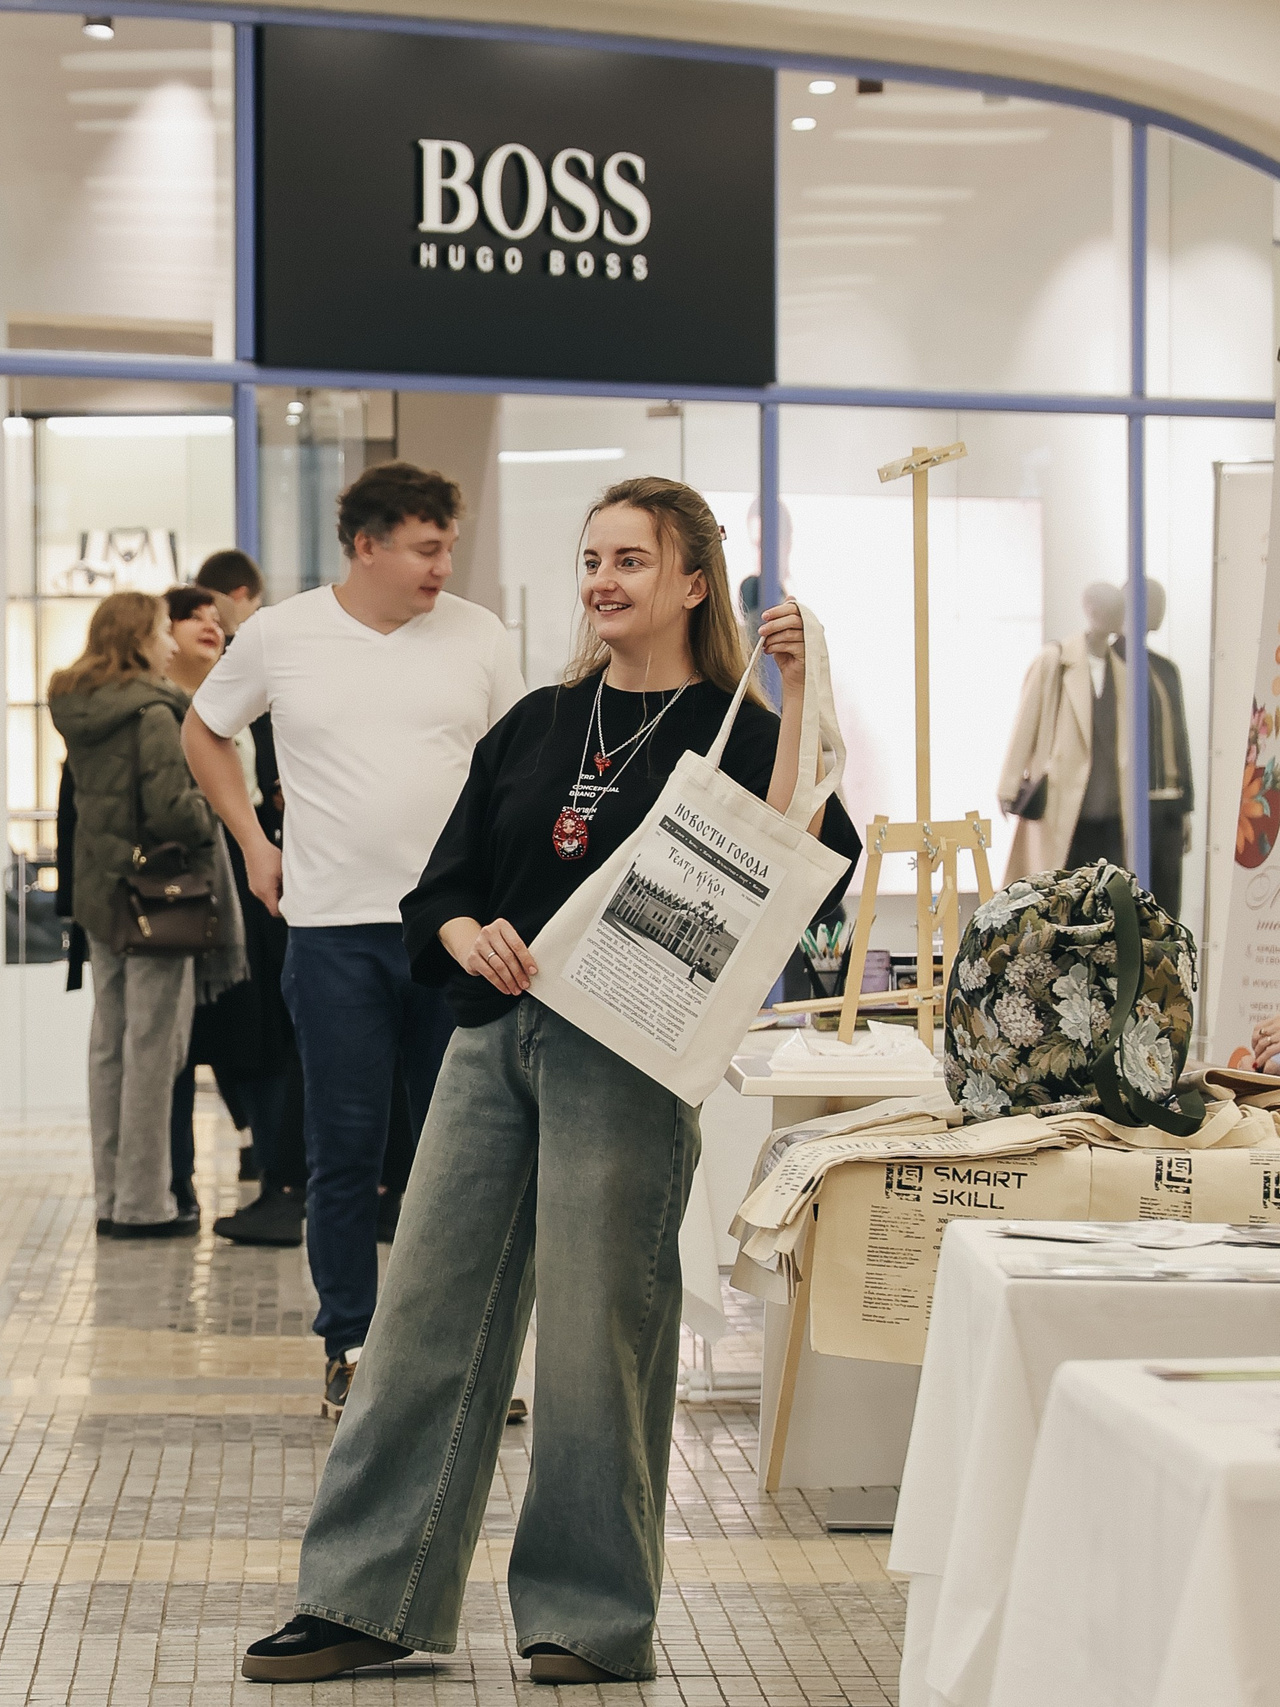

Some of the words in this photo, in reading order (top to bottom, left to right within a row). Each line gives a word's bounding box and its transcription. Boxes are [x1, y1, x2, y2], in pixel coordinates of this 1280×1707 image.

[418, 138, 652, 246] BOSS
[419, 242, 523, 275] HUGO
[548, 249, 649, 282] BOSS
[674, 803, 727, 849] НОВОСТИ
[726, 842, 769, 878] ГОРОДА
[933, 1166, 1028, 1189] SMART
[932, 1189, 1005, 1210] SKILL
